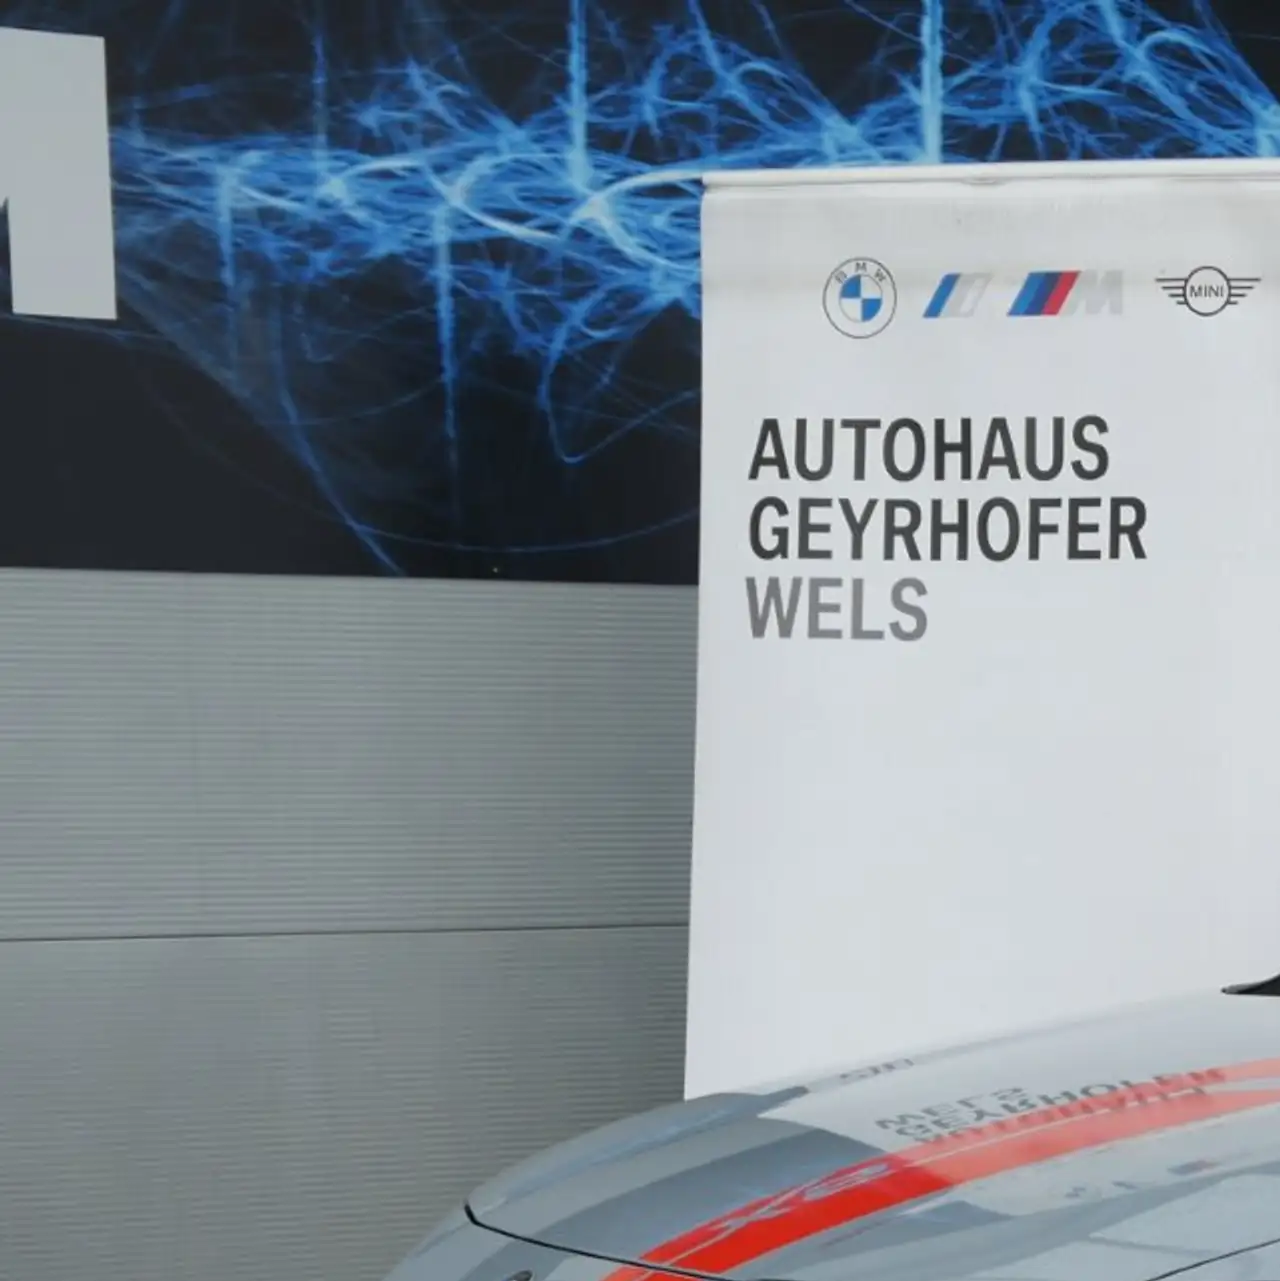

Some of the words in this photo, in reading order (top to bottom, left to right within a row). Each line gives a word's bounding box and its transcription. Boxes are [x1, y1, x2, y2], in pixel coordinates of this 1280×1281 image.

[1189, 284, 1225, 298] MINI
[747, 415, 1111, 482] AUTOHAUS
[748, 496, 1148, 561] GEYRHOFER
[745, 576, 929, 641] WELS
